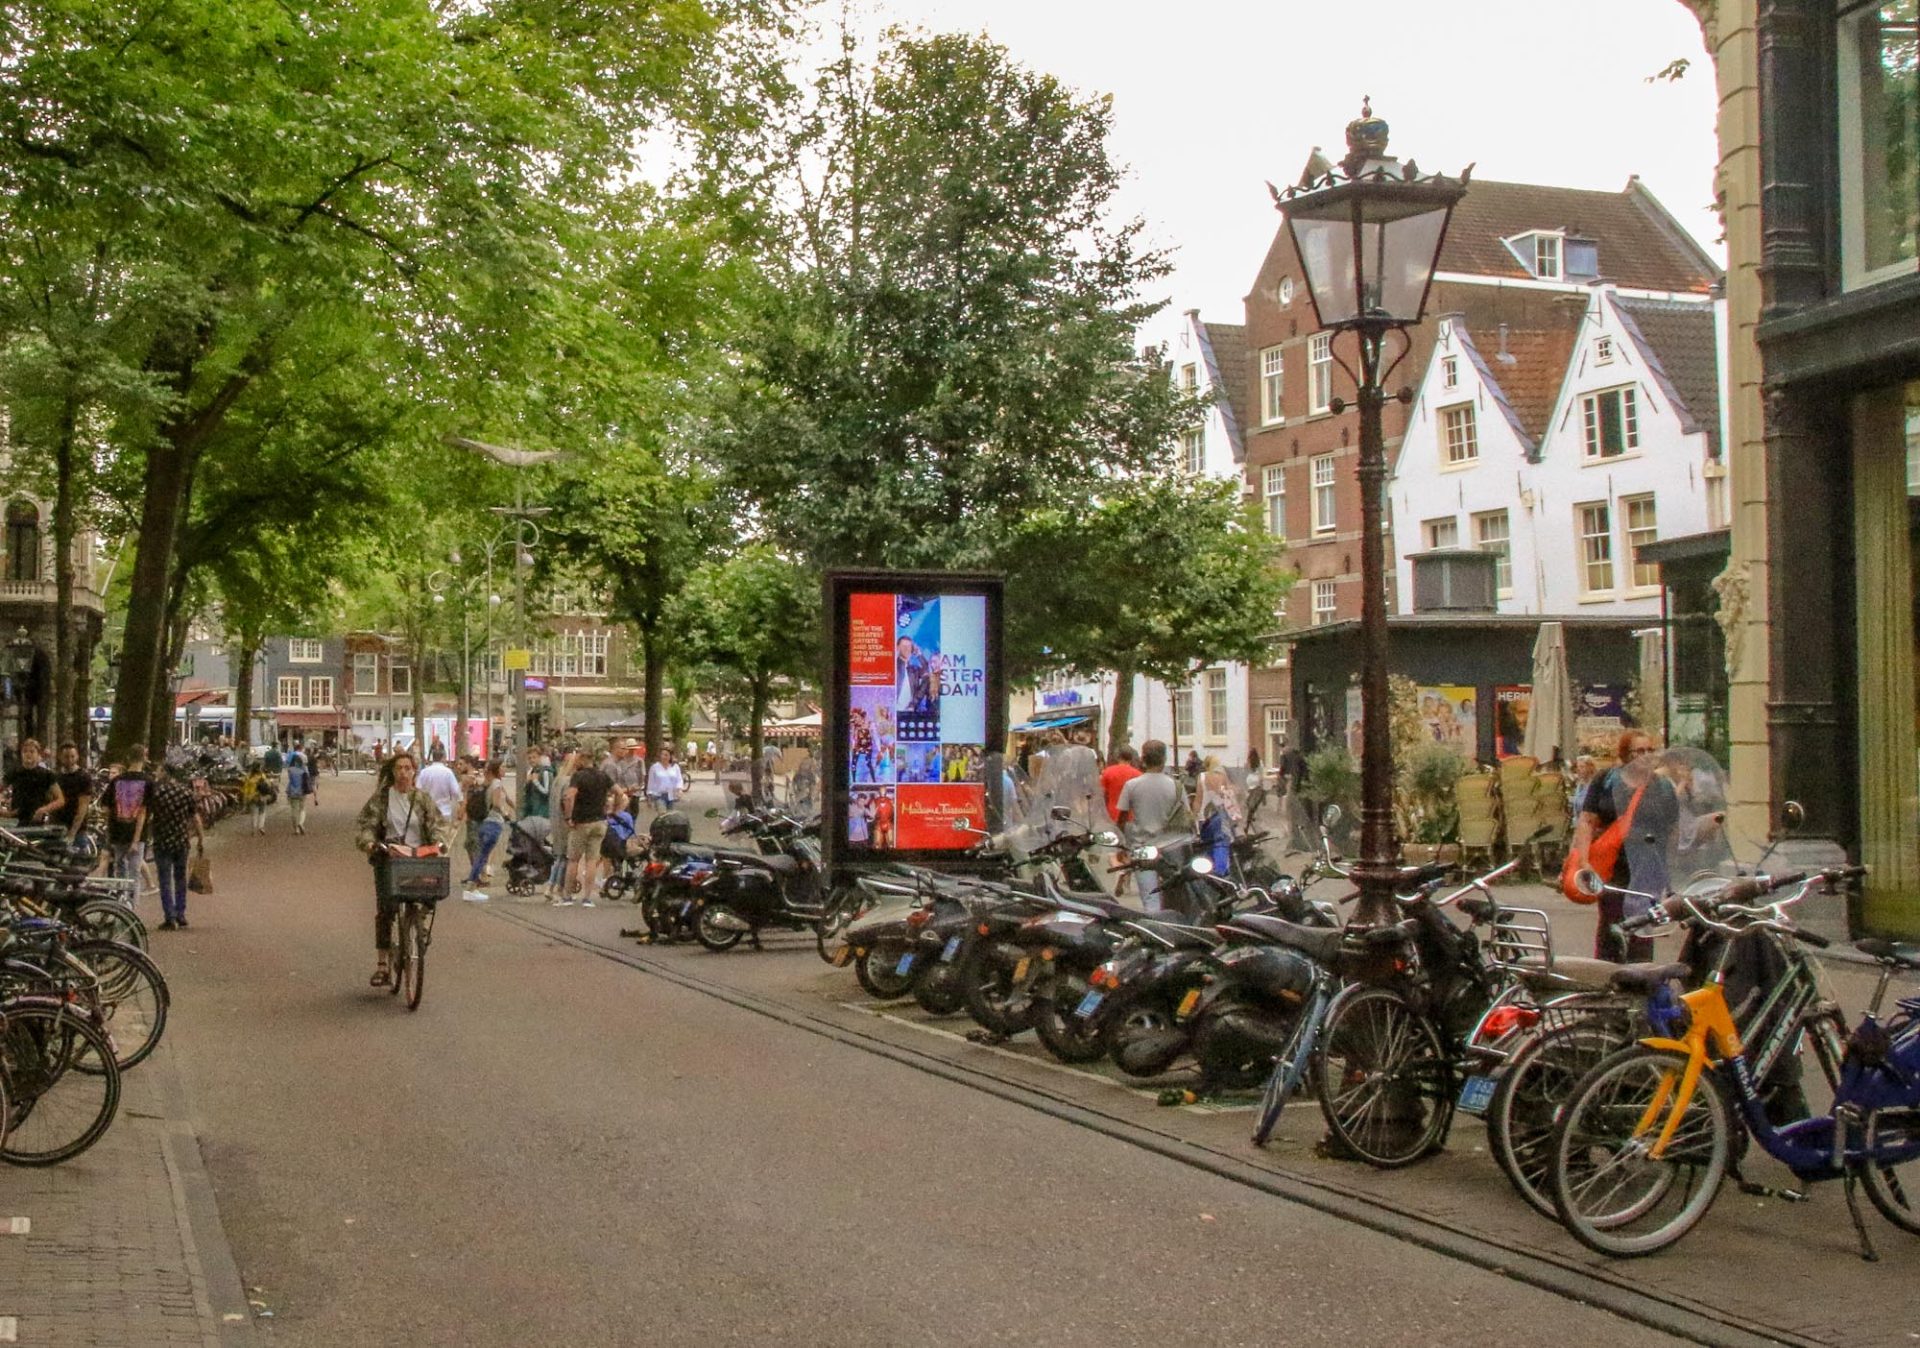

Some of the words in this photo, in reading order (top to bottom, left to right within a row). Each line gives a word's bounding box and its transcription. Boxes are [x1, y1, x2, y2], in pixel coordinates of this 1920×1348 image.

[941, 654, 966, 667] AM
[940, 668, 983, 682] STER
[940, 683, 978, 697] DAM
